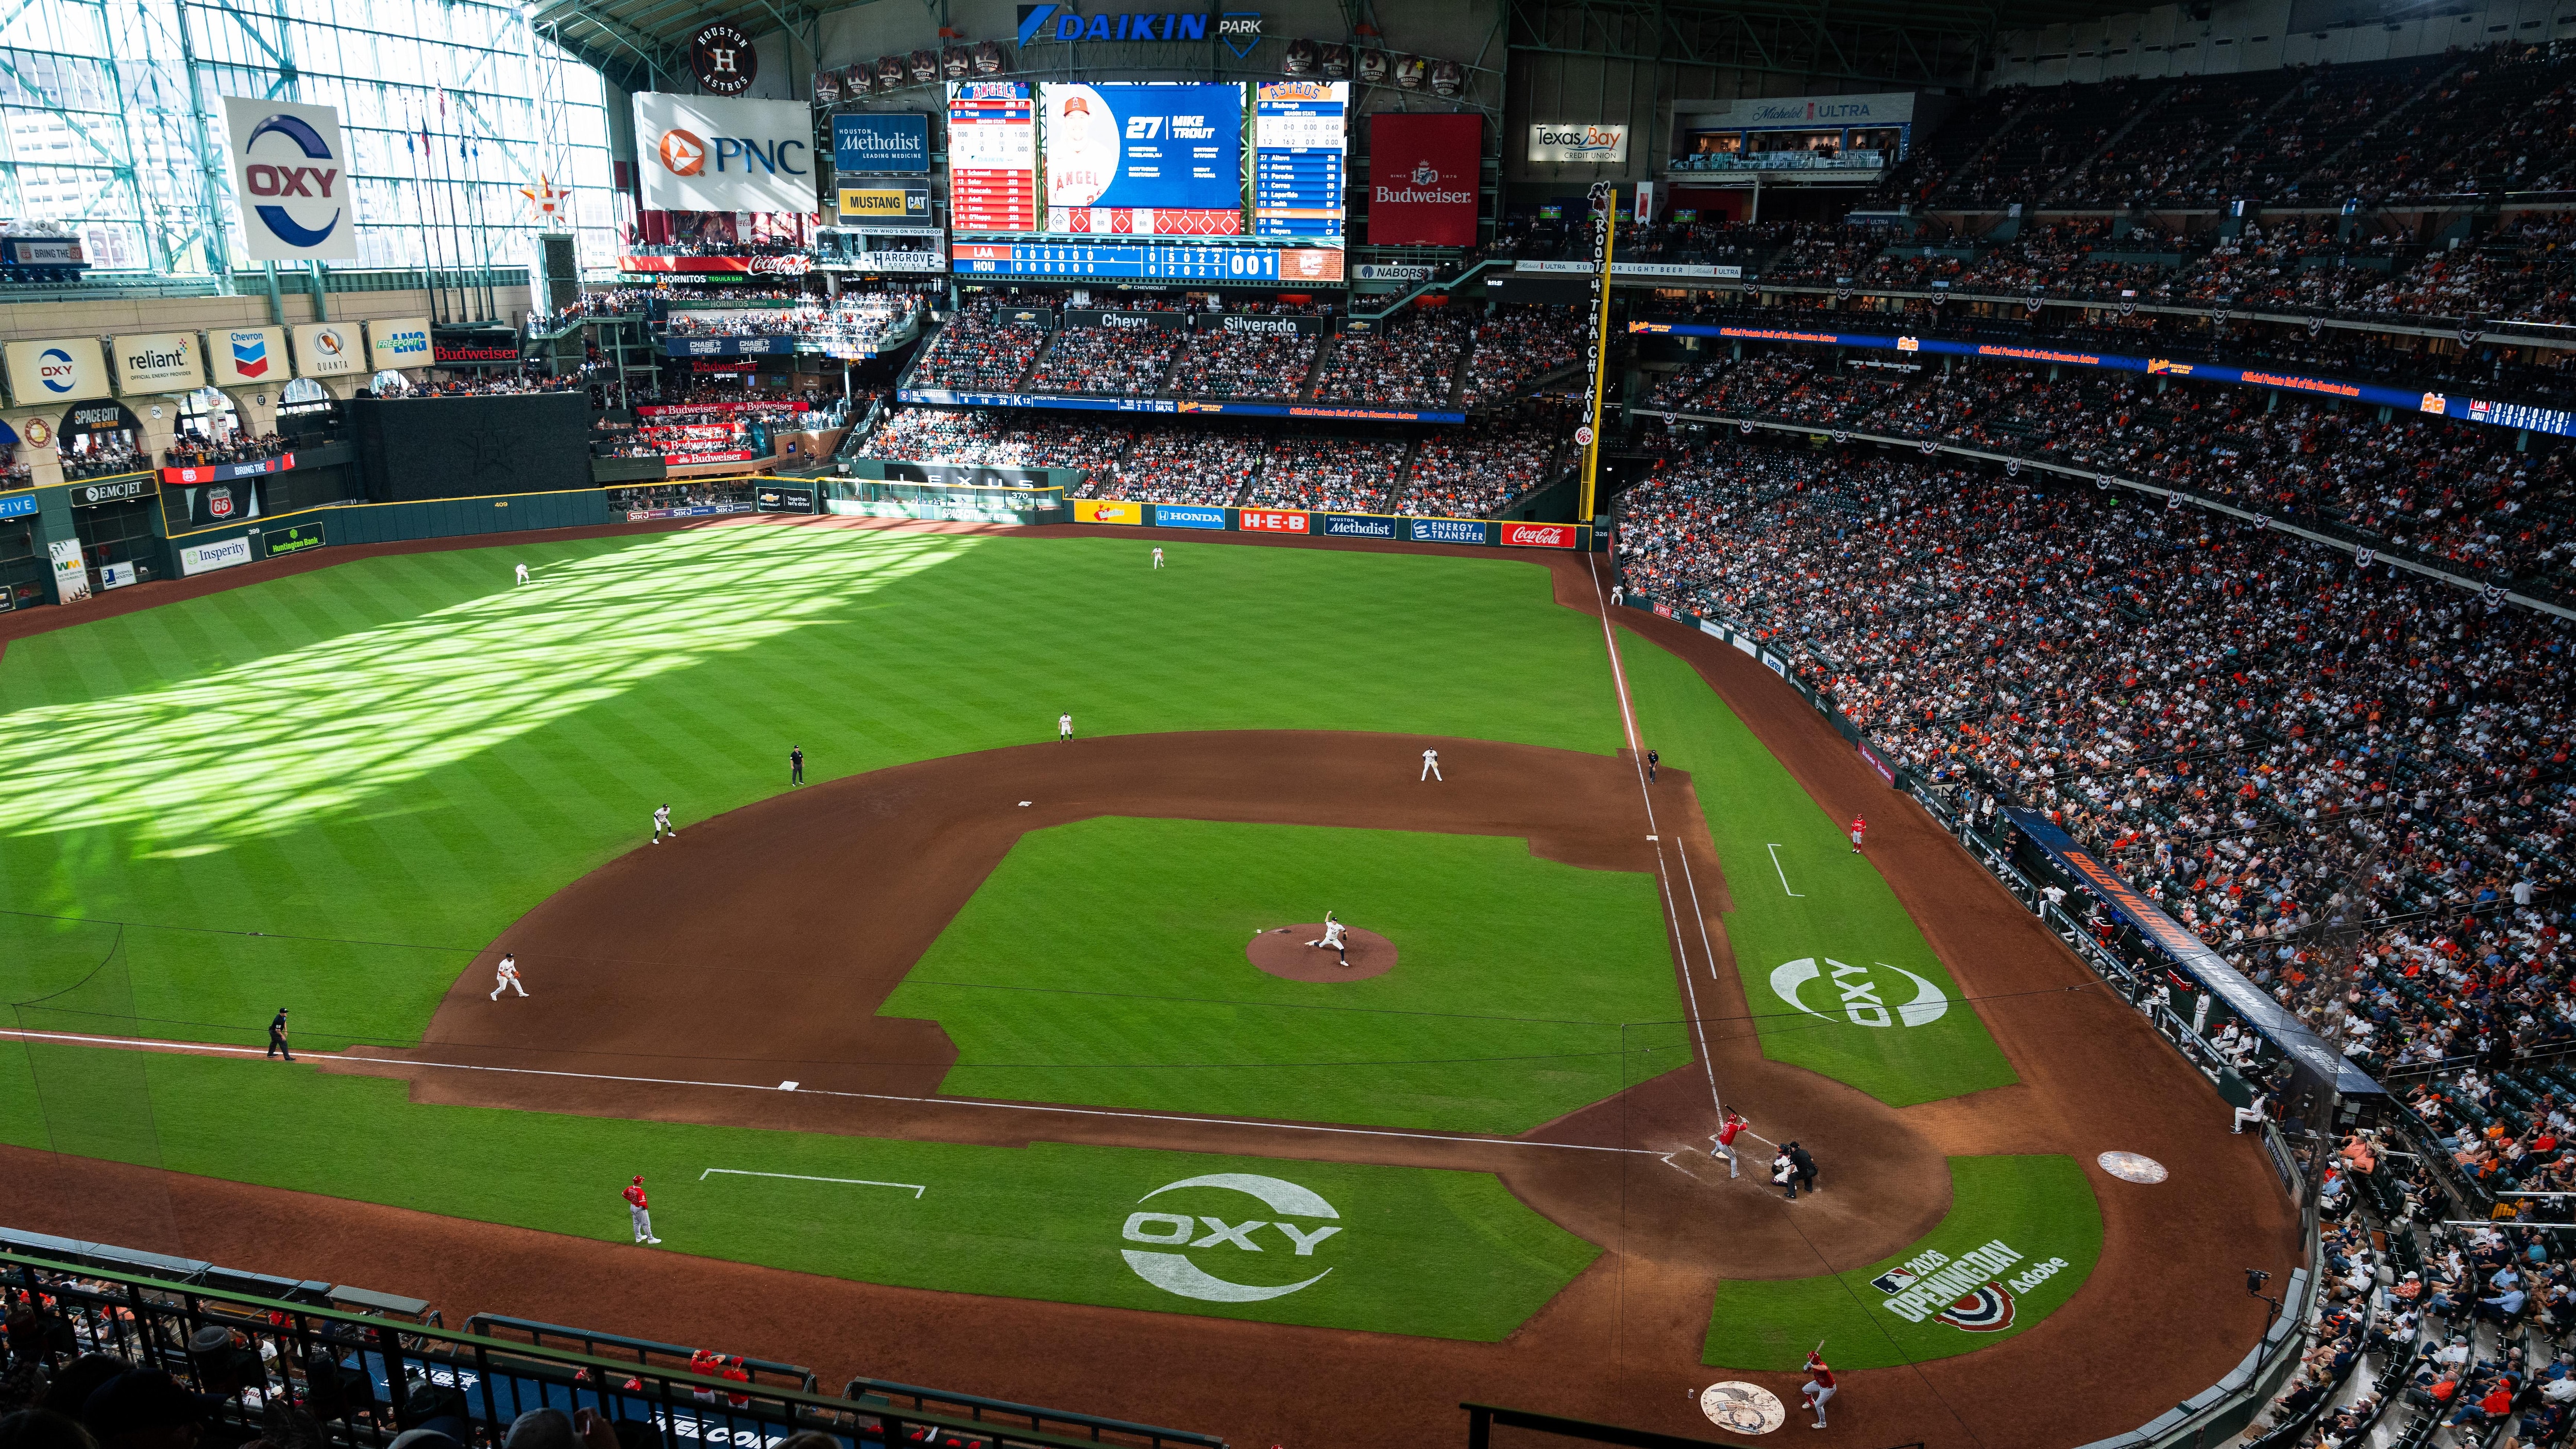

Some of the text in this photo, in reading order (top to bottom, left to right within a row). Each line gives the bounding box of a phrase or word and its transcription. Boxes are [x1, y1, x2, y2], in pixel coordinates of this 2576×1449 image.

[1055, 14, 1261, 40] DAIKIN PARK
[698, 27, 748, 48] HOUSTON
[878, 57, 901, 76] 25
[703, 74, 748, 91] ASTROS
[973, 84, 1016, 99] ANGELS
[1270, 82, 1319, 99] ASTROS
[1752, 104, 1870, 121] Michelob ULTRA
[1126, 116, 1163, 138] 27
[1172, 116, 1204, 126] MIKE
[1173, 128, 1215, 138] TROUT
[1536, 127, 1621, 151] Texas Bay
[840, 132, 921, 150] Methodist
[710, 137, 807, 174] PNC
[247, 164, 337, 197] OXY
[850, 196, 925, 209] MUSTANG CAT
[1376, 187, 1470, 203] Budweiser
[35, 249, 56, 258] BRING
[56, 249, 70, 258] THE
[974, 247, 994, 257] LAA
[874, 253, 935, 267] HARGROVE
[973, 261, 995, 272] HOU
[1377, 268, 1422, 277] NABORS
[1591, 279, 1600, 292] 4
[1224, 317, 1296, 334] Silverado
[231, 332, 263, 341] Chevron
[377, 331, 427, 353] FREEPORT LNG
[434, 346, 518, 360] Budweiser
[823, 343, 878, 352] PLUCKERS
[129, 349, 184, 369] reliant
[317, 361, 348, 371] QUANTA
[41, 365, 72, 377] OXY
[668, 406, 718, 414] Budweiser
[747, 402, 793, 411] Budweiser
[2475, 400, 2486, 410] LAA
[75, 407, 119, 425] SPACE CITY
[2471, 412, 2485, 421] HOU
[691, 453, 741, 463] Budweiser
[235, 466, 255, 476] BRING
[256, 463, 265, 472] THE
[99, 482, 142, 499] EMCJET
[0, 500, 32, 513] FIVE
[214, 500, 227, 512] 66
[1170, 513, 1223, 523] HONDA
[1330, 523, 1389, 535] Methodist
[1432, 523, 1473, 532] ENERGY
[1513, 526, 1561, 544] Coca-Cola
[1432, 530, 1483, 541] TRANSFER
[199, 543, 244, 561] Insperity
[273, 537, 318, 552] Huntington Bank
[56, 560, 80, 571] WM
[1659, 605, 1670, 615] SPEC'S
[2063, 851, 2130, 893] ASTROS
[2120, 894, 2199, 950] HOUSTON
[1825, 957, 1892, 1026] OXY
[1122, 1211, 1343, 1255] OXY
[1904, 1249, 1950, 1276] 2026
[1883, 1239, 2024, 1322] OPENING DAY
[2008, 1257, 2069, 1294] Adobe
[648, 1416, 784, 1449] WELCOM
